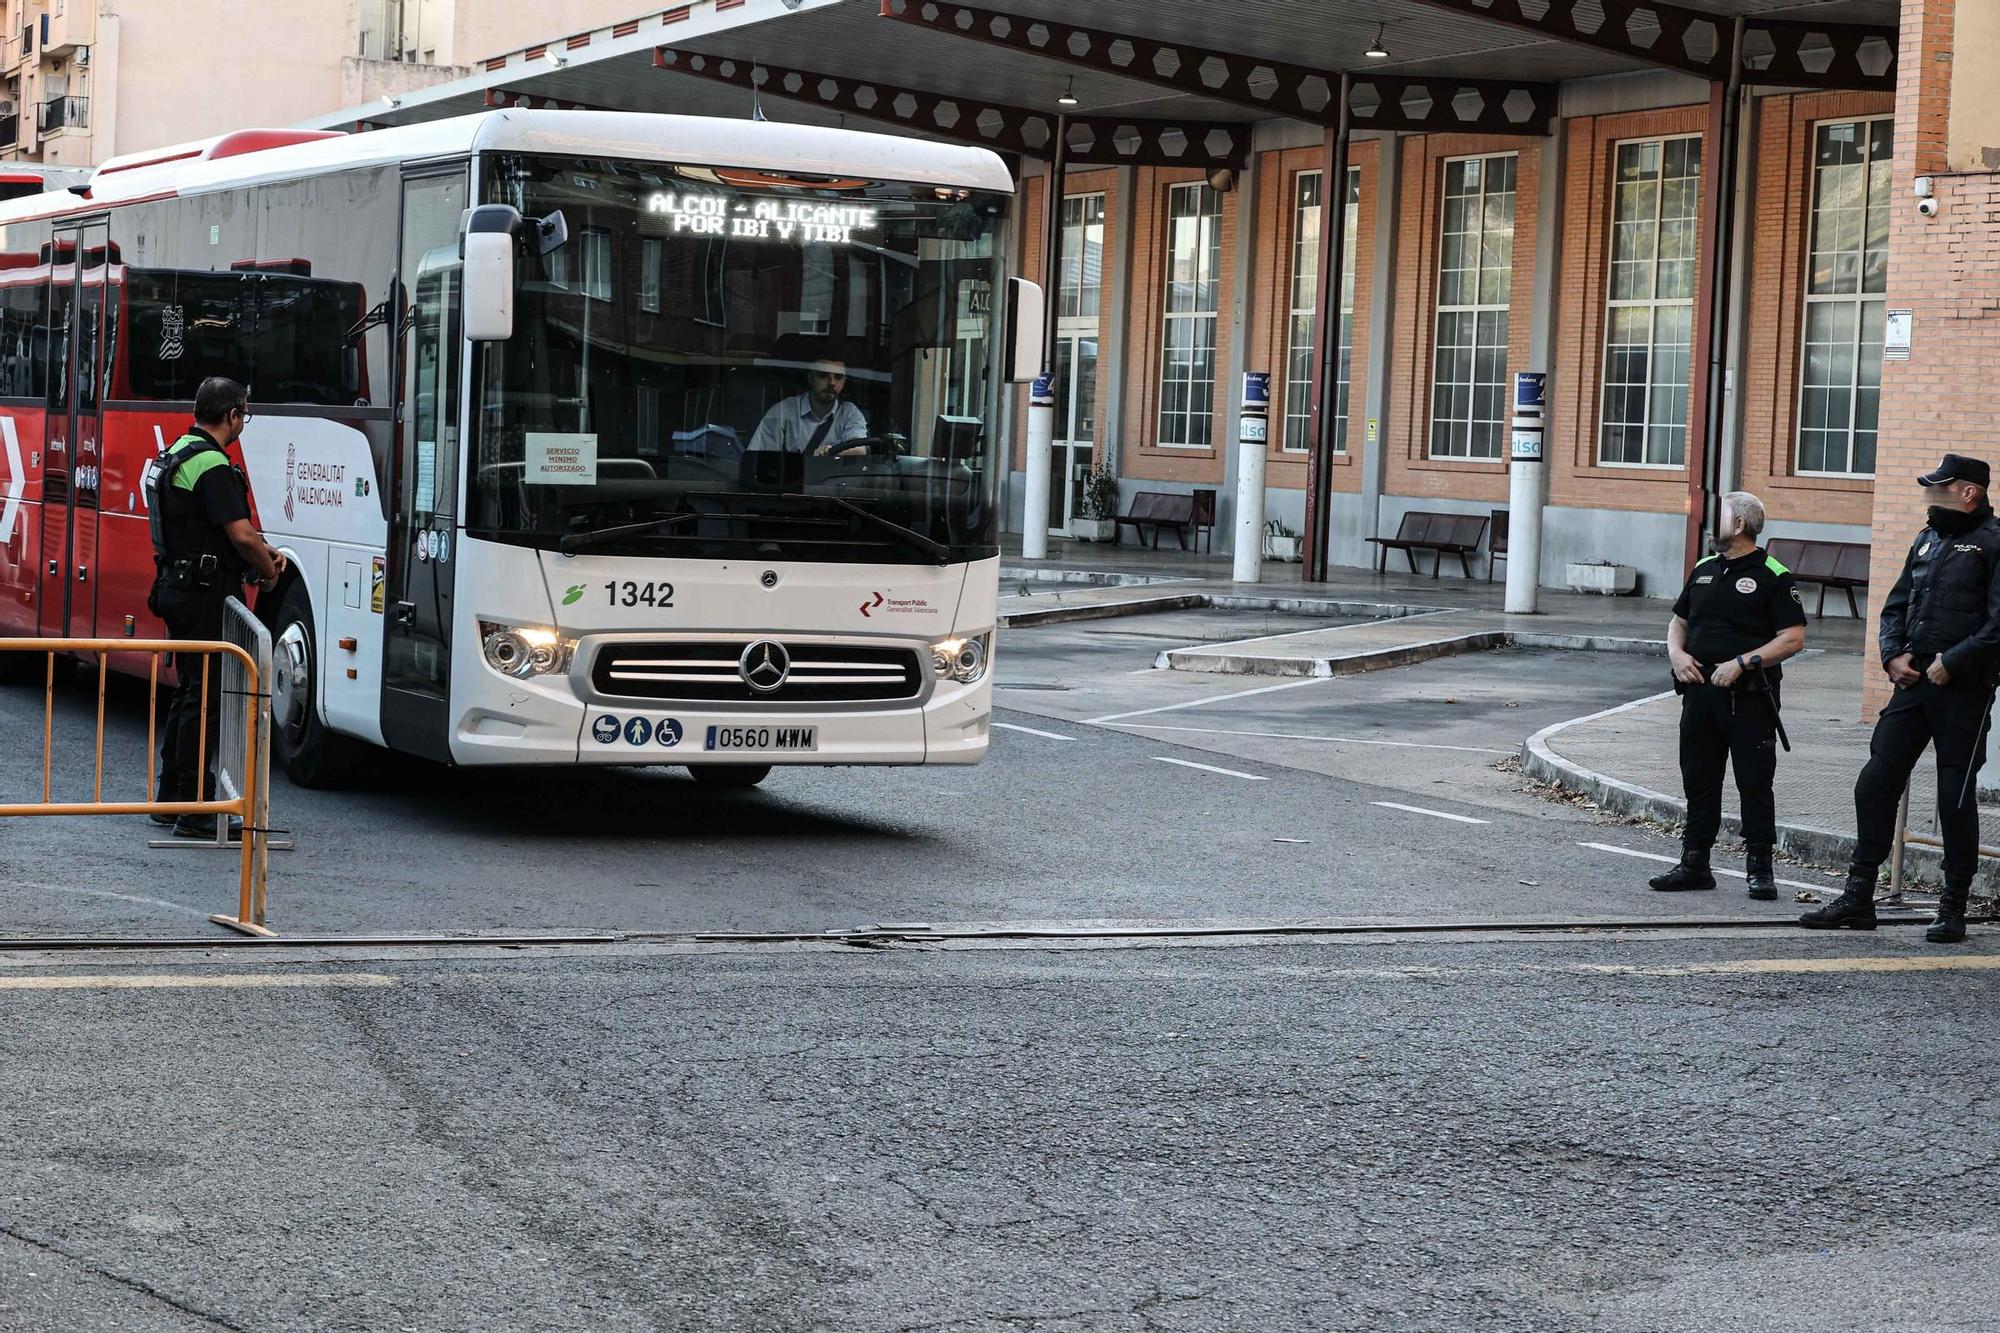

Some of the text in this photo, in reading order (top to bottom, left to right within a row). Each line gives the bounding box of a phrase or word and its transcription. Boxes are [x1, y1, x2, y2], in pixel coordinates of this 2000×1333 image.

[649, 193, 727, 216] ALCOI
[754, 202, 876, 228] ALICANTE
[673, 214, 851, 243] POR IBI Y TIBI
[297, 462, 346, 483] GENERALITAT
[297, 486, 343, 508] VALENCIANA
[604, 580, 674, 608] 1342
[720, 729, 812, 748] 0560 MWM
